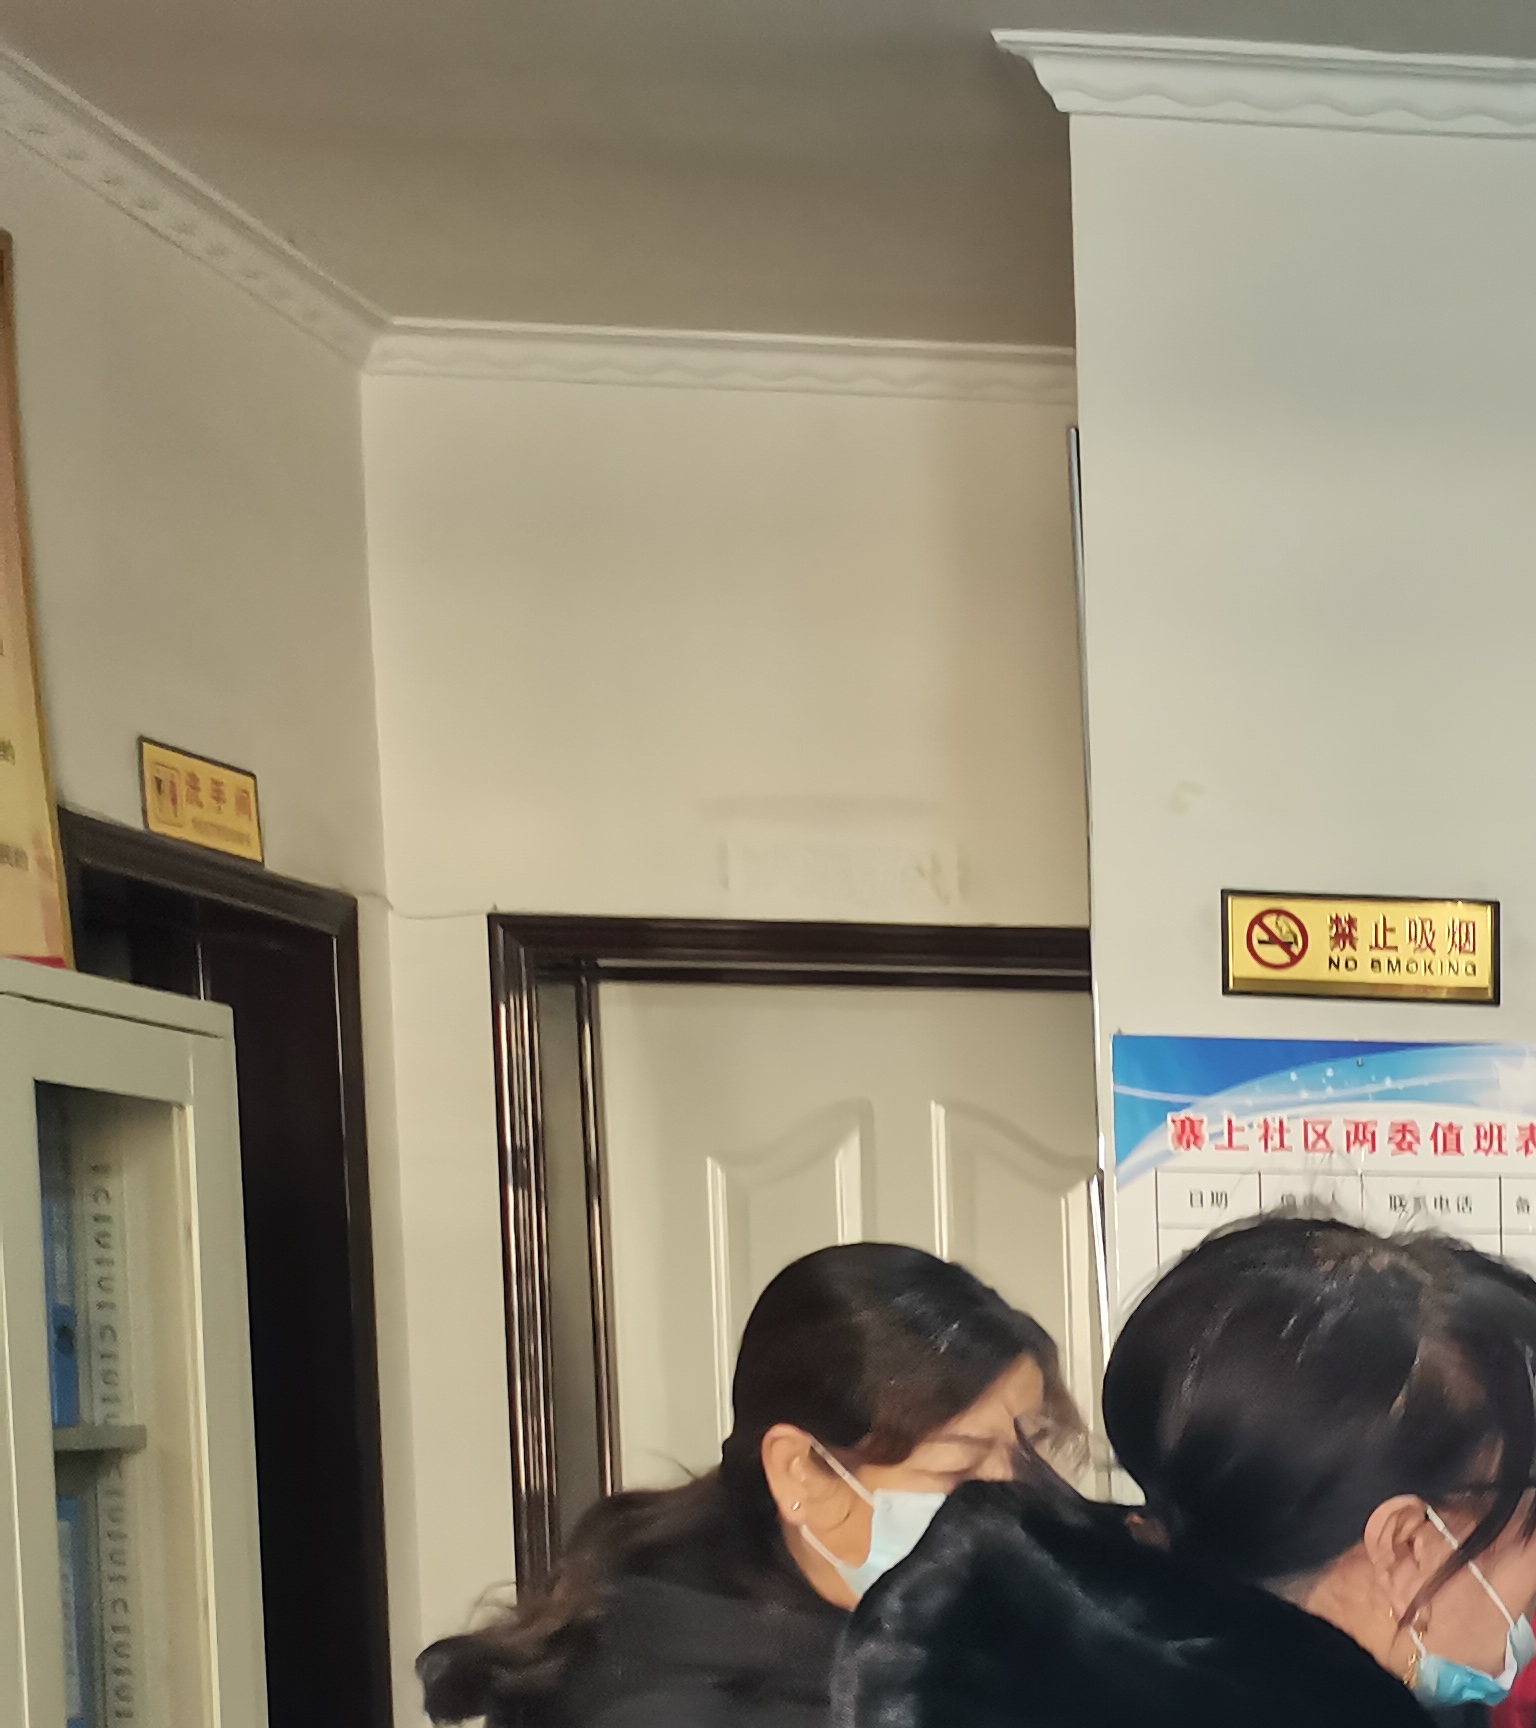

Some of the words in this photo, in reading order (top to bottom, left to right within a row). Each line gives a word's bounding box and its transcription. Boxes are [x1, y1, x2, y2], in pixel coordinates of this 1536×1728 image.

[1327, 912, 1477, 955] 禁止吸烟
[1328, 957, 1358, 972] NO
[1370, 957, 1477, 977] SMOKING
